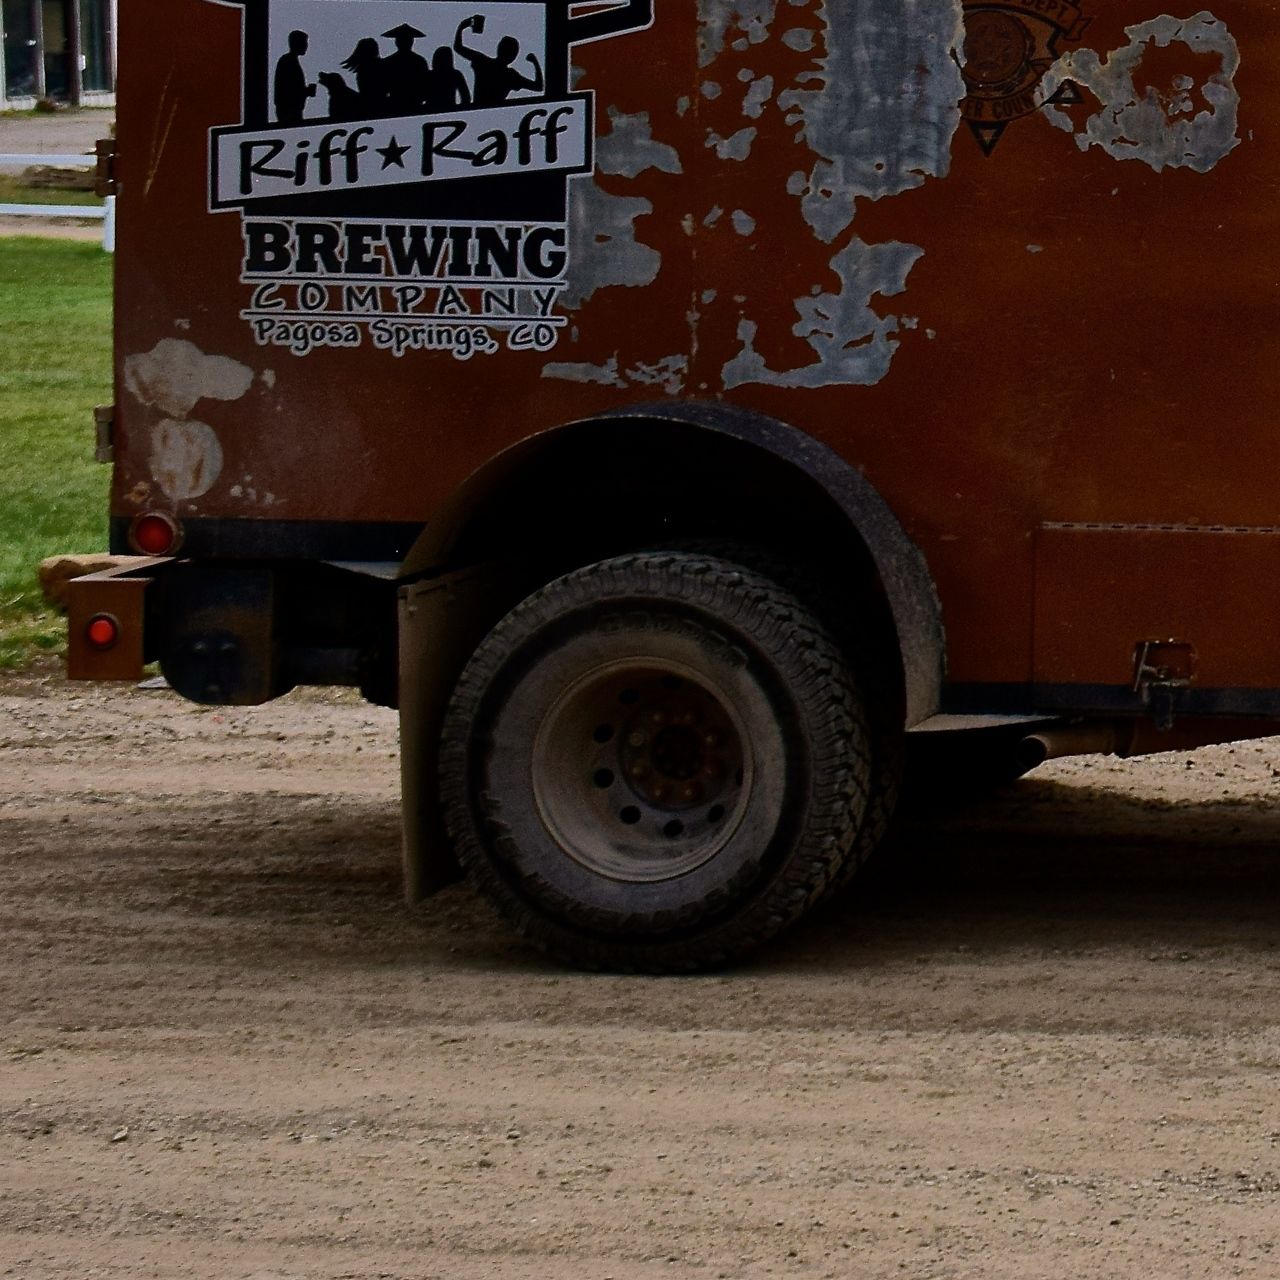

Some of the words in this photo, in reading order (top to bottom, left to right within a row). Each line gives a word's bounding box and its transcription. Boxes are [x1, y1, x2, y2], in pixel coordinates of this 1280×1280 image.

[239, 126, 375, 195] Riff
[421, 106, 575, 177] Raff
[245, 222, 568, 279] BREWING
[253, 282, 556, 317] COMPANY
[254, 319, 360, 352] Pagosa
[372, 320, 497, 356] Springs,
[510, 323, 556, 347] CO
